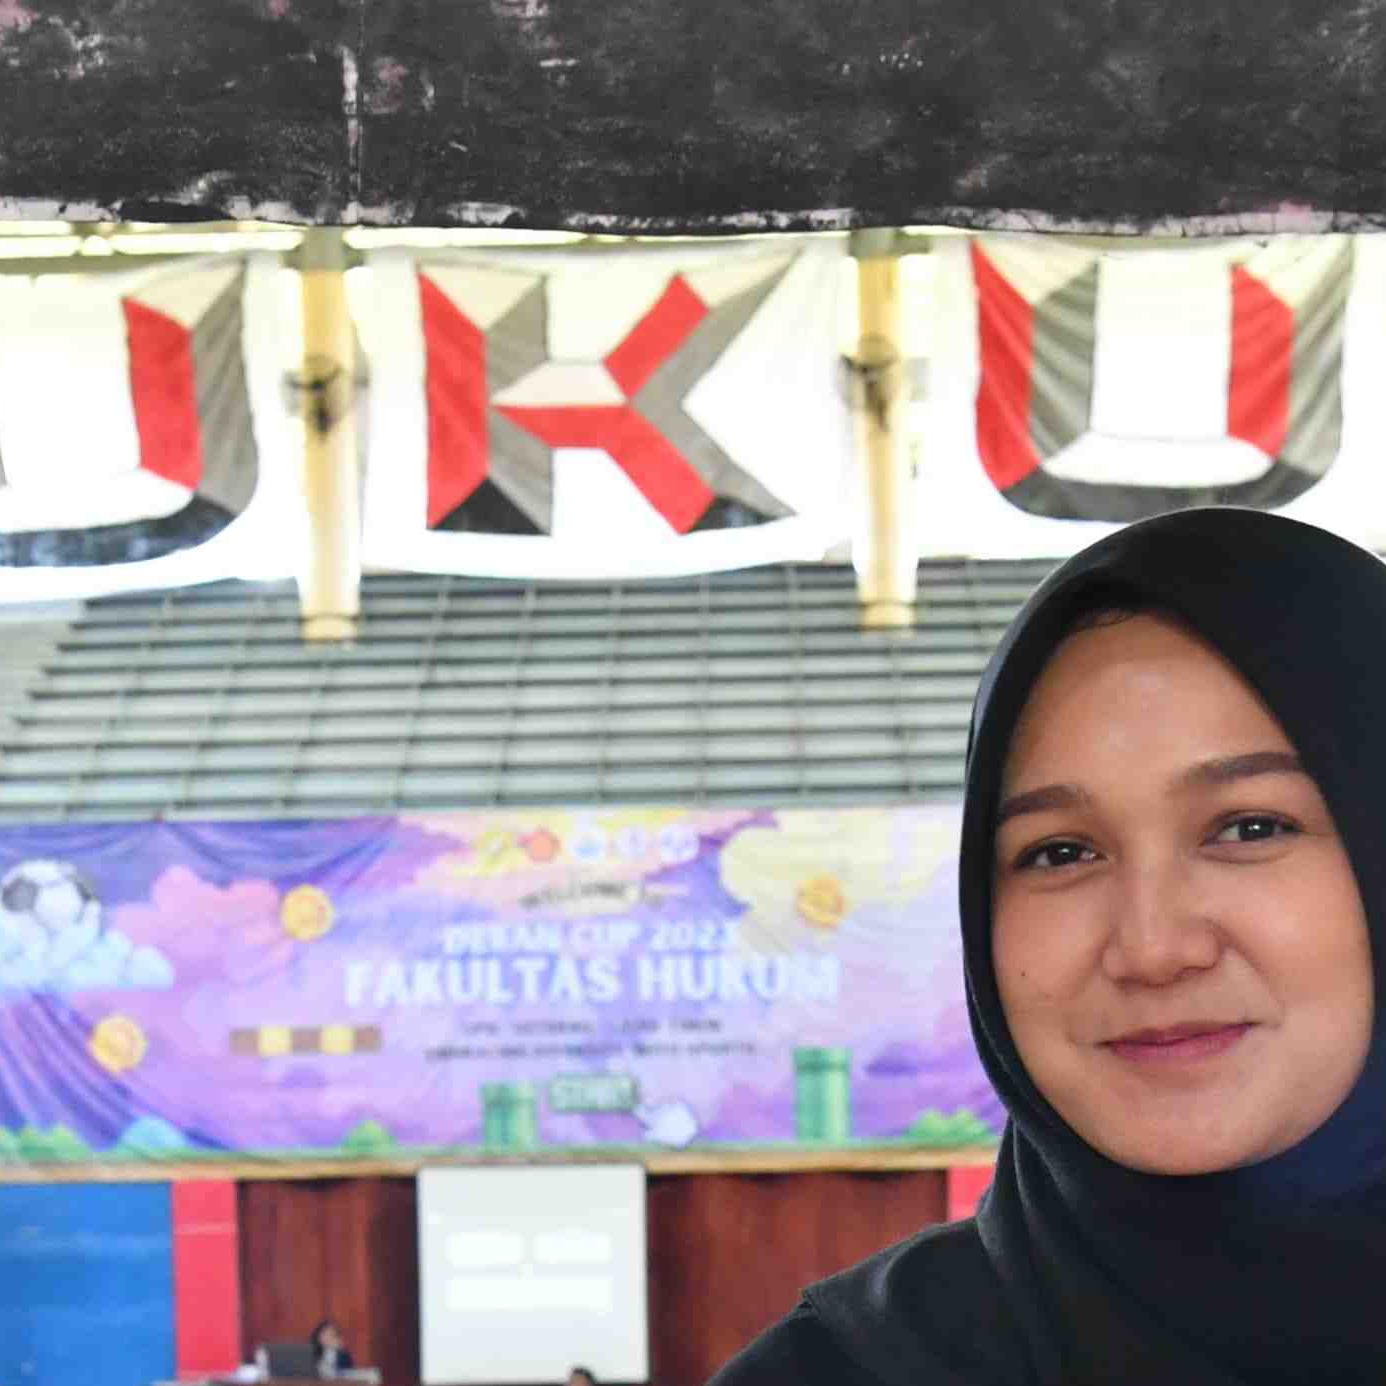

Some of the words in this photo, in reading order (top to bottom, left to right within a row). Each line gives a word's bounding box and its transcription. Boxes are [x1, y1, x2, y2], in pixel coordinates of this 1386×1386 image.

[570, 921, 642, 952] CUP
[342, 957, 621, 1008] FAKULTAS
[636, 953, 841, 1003] HUKUM
